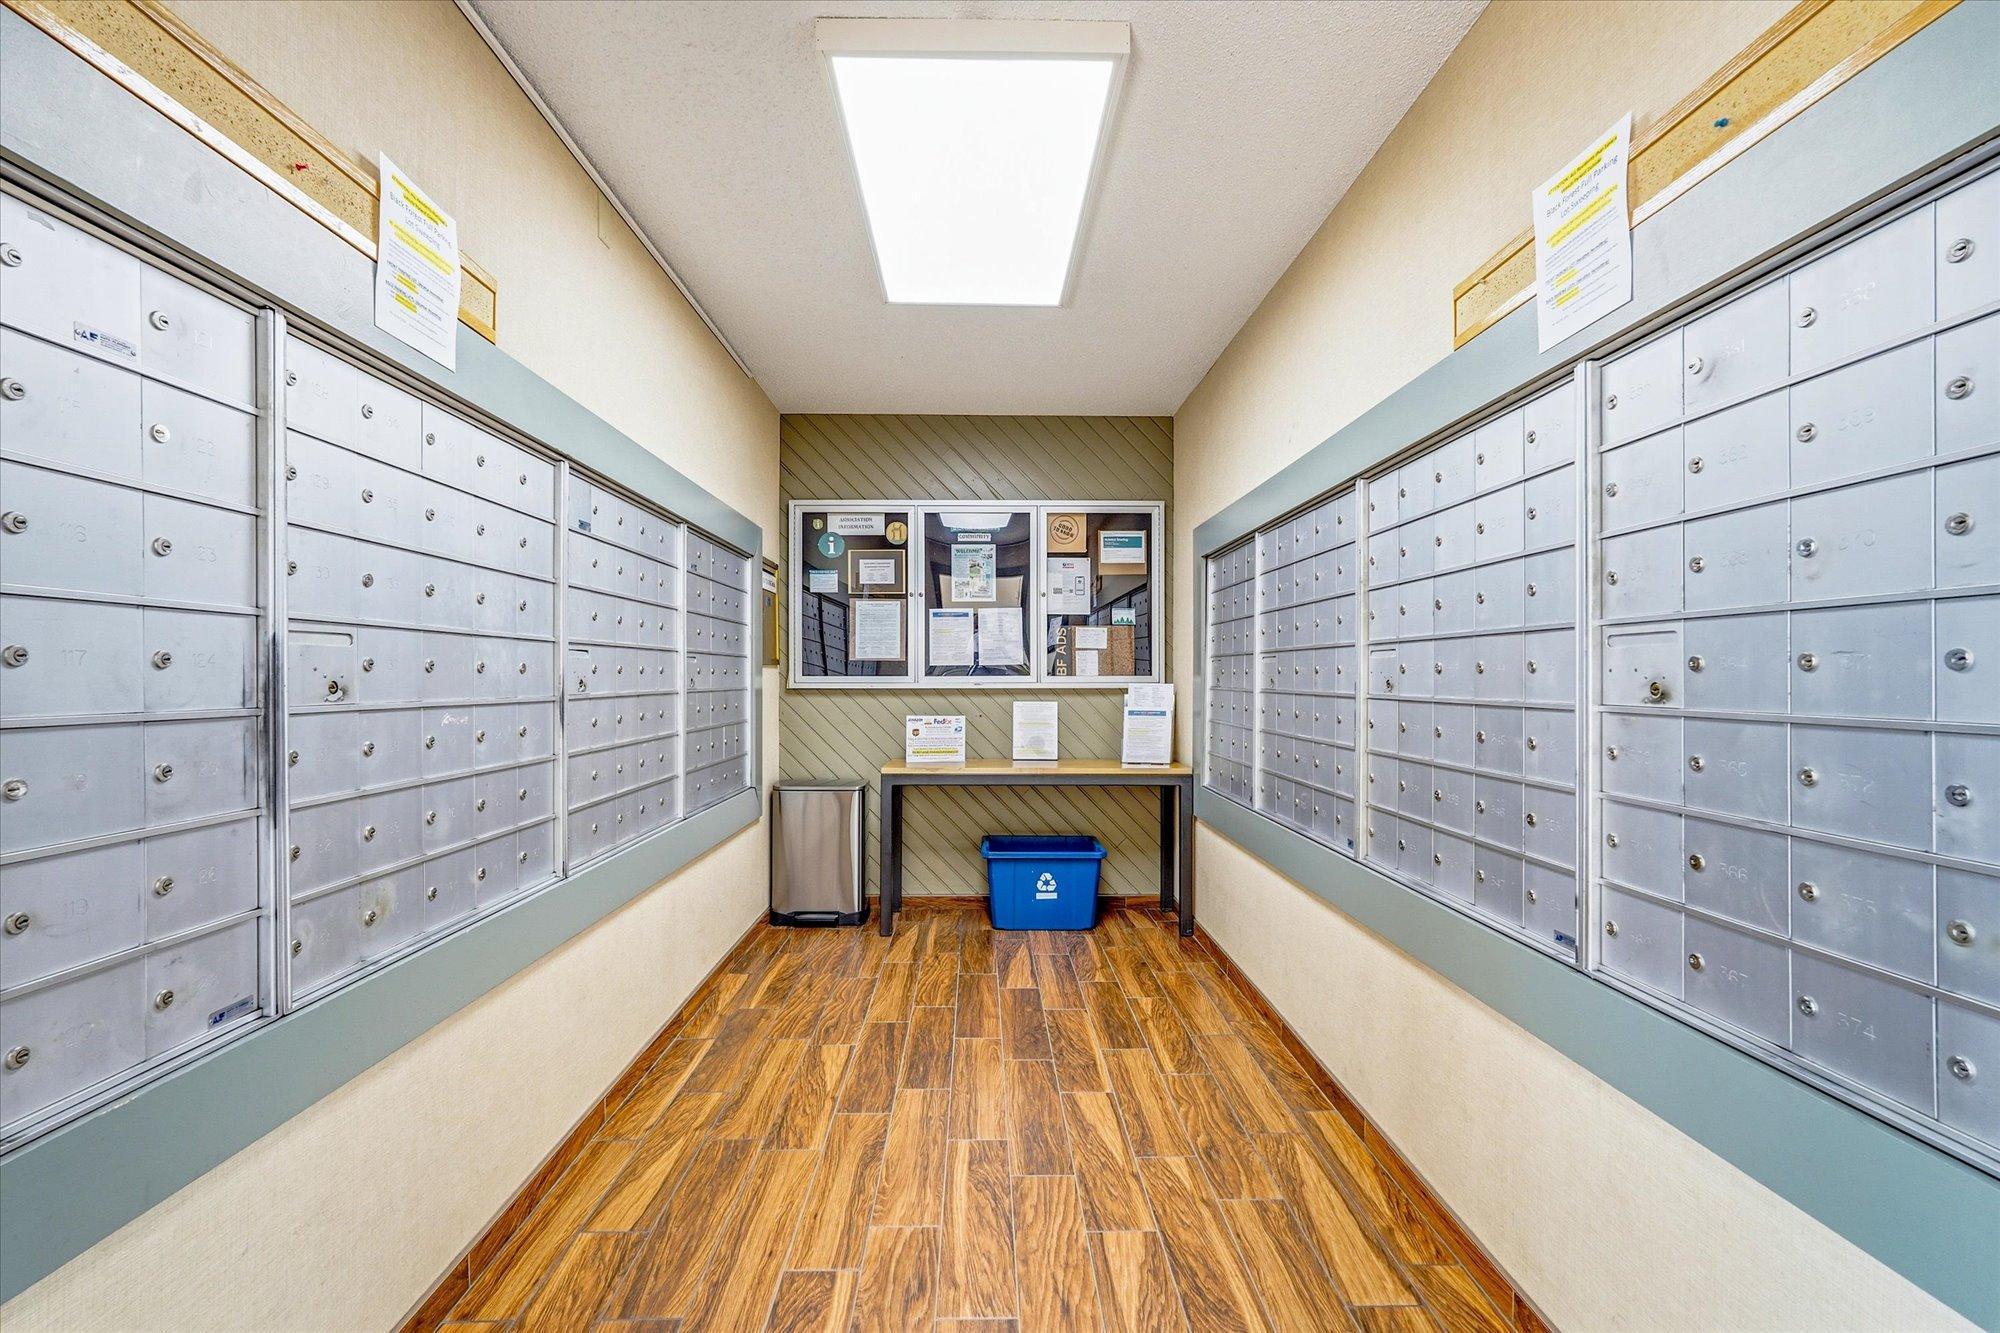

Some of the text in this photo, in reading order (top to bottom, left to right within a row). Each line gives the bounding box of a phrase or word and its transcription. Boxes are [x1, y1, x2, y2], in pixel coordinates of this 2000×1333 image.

[389, 192, 405, 209] Black
[1546, 202, 1561, 218] Black
[1561, 186, 1579, 204] Forest
[1593, 154, 1618, 179] Parking
[1560, 182, 1599, 218] Lot Sweeping
[1056, 627, 1067, 676] BF ADS
[1719, 862, 1749, 882] 366
[1837, 1011, 1878, 1041] 374
